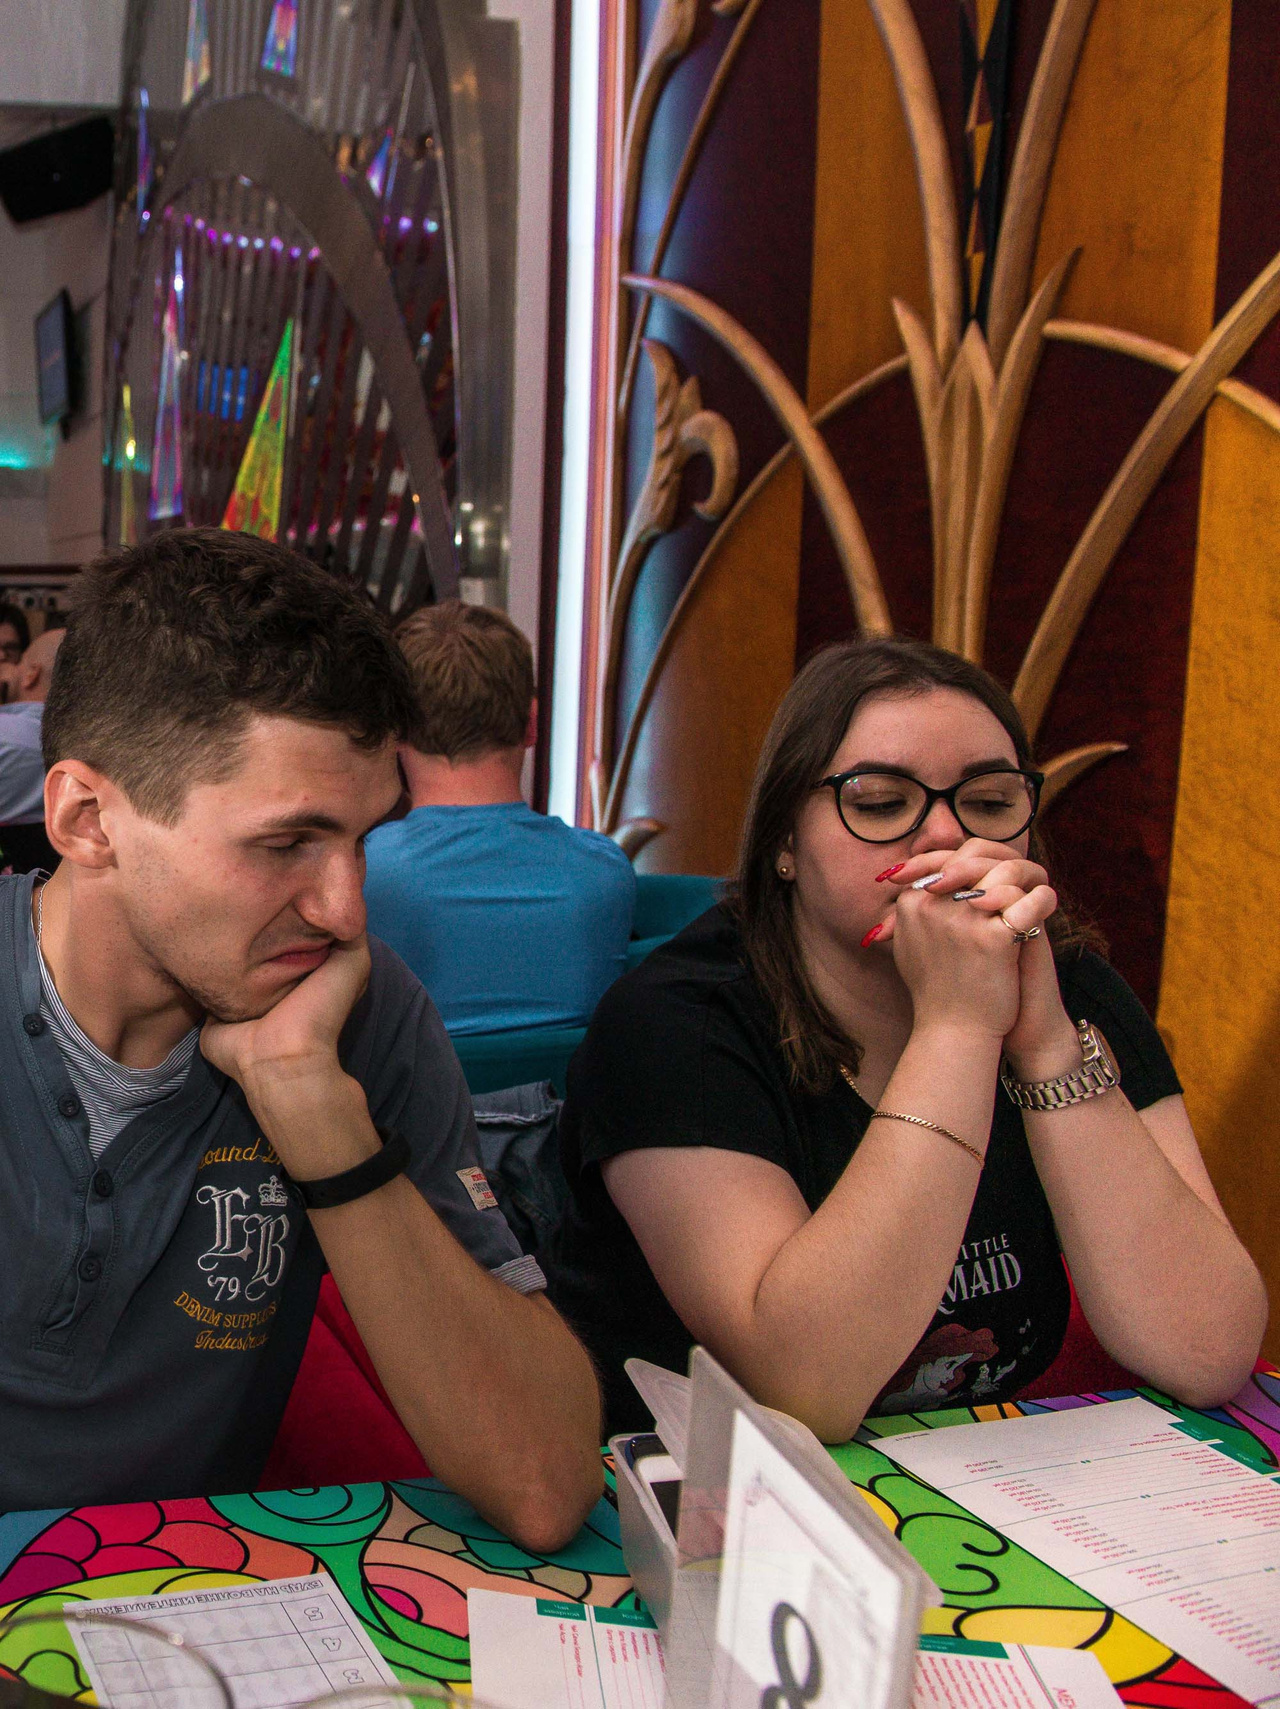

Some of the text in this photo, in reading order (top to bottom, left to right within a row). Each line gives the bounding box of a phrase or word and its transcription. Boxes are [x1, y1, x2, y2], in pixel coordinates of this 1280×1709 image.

[198, 1137, 261, 1171] ound
[960, 1232, 1011, 1260] ITTLE
[937, 1252, 1021, 1315] MAID
[174, 1290, 222, 1327] DENIM
[253, 1586, 280, 1598] НА
[280, 1579, 324, 1595] БУДЬ
[195, 1589, 251, 1605] ВОЛНЕ
[303, 1606, 324, 1622] 5
[321, 1636, 342, 1652] 4
[342, 1668, 365, 1685] 3
